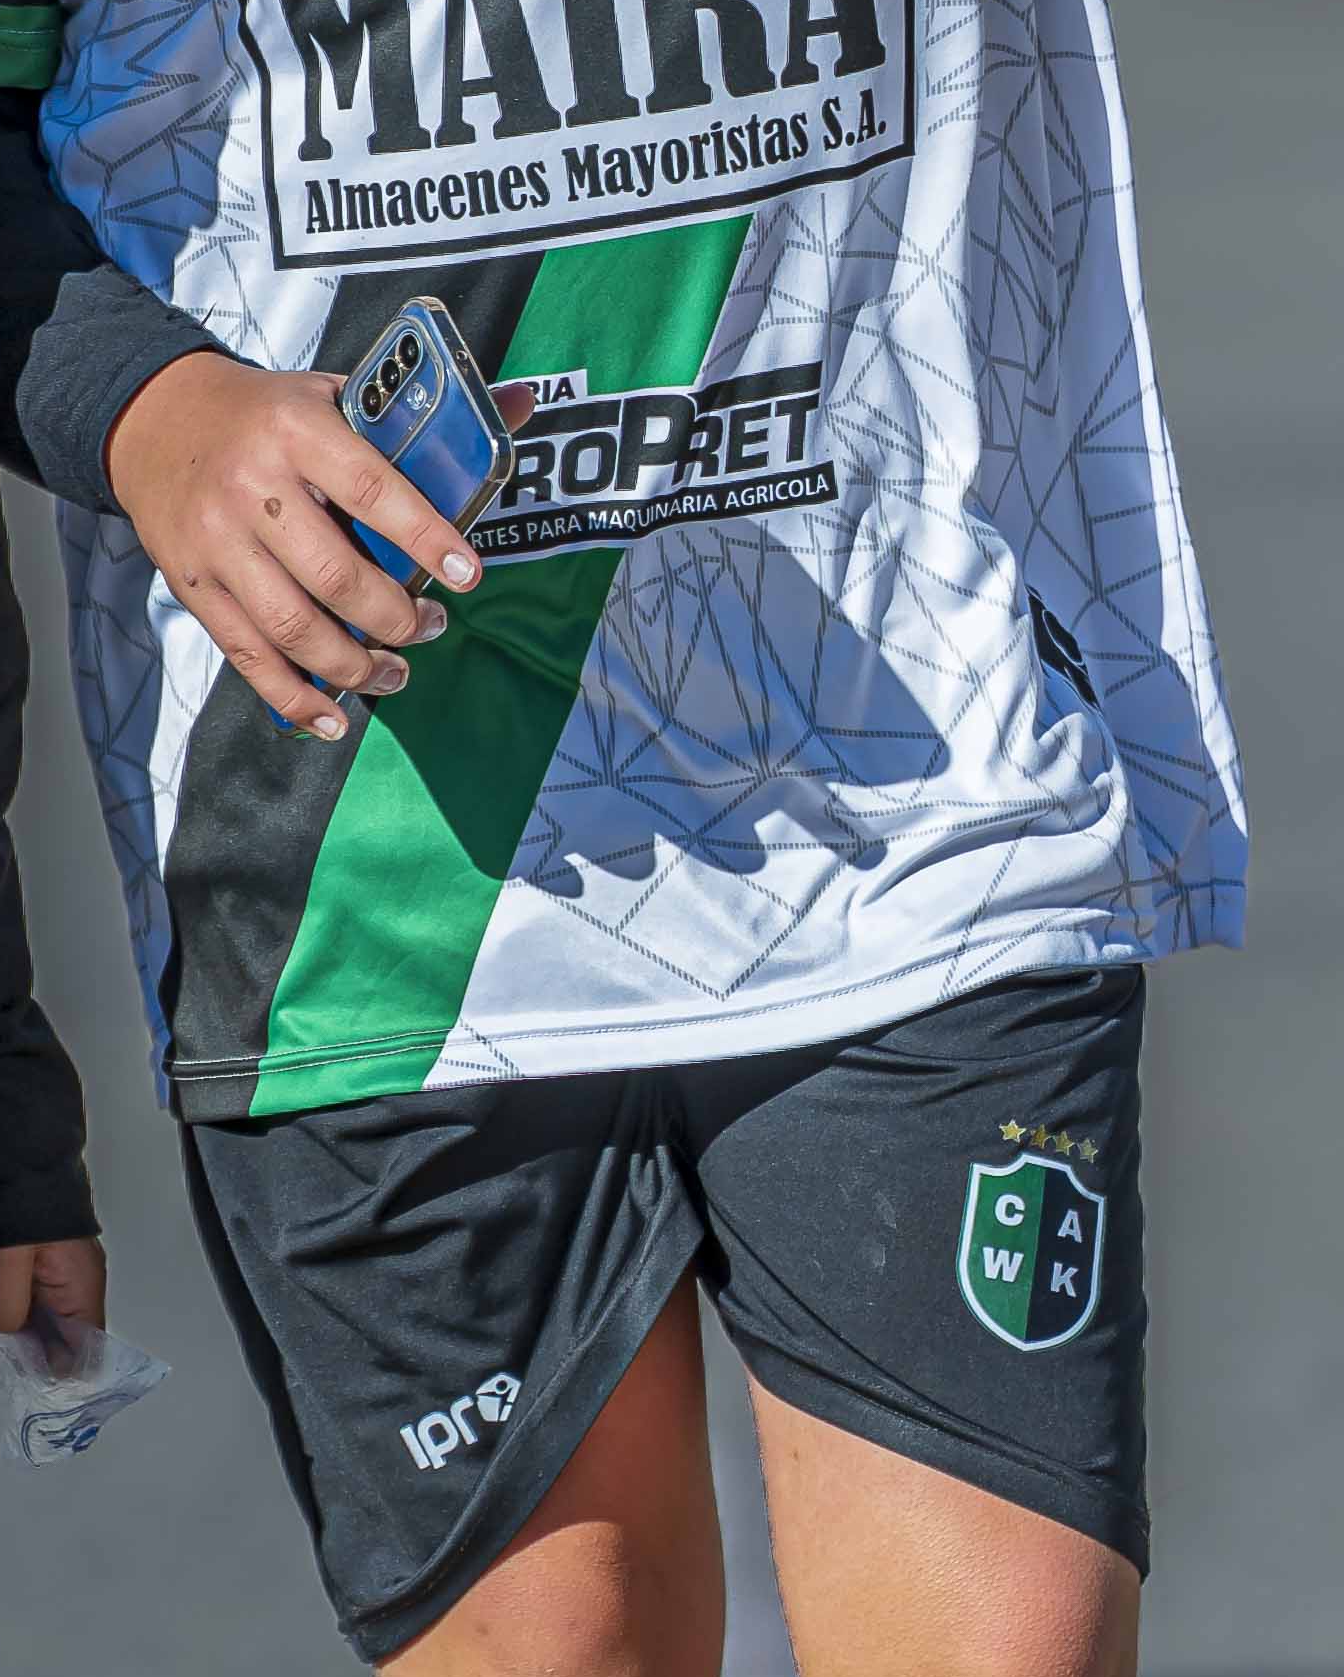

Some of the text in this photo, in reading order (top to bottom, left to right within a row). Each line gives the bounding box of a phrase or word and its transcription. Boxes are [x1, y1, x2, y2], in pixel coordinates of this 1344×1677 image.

[305, 88, 888, 234] Almacenes Mayoristas S.A.
[525, 376, 577, 405] RIA
[500, 393, 820, 510] ROPRET
[470, 473, 830, 550] RTES PARA MAQUINARIA AGRICOLA
[994, 1194, 1083, 1244] C A
[983, 1246, 1079, 1298] W K
